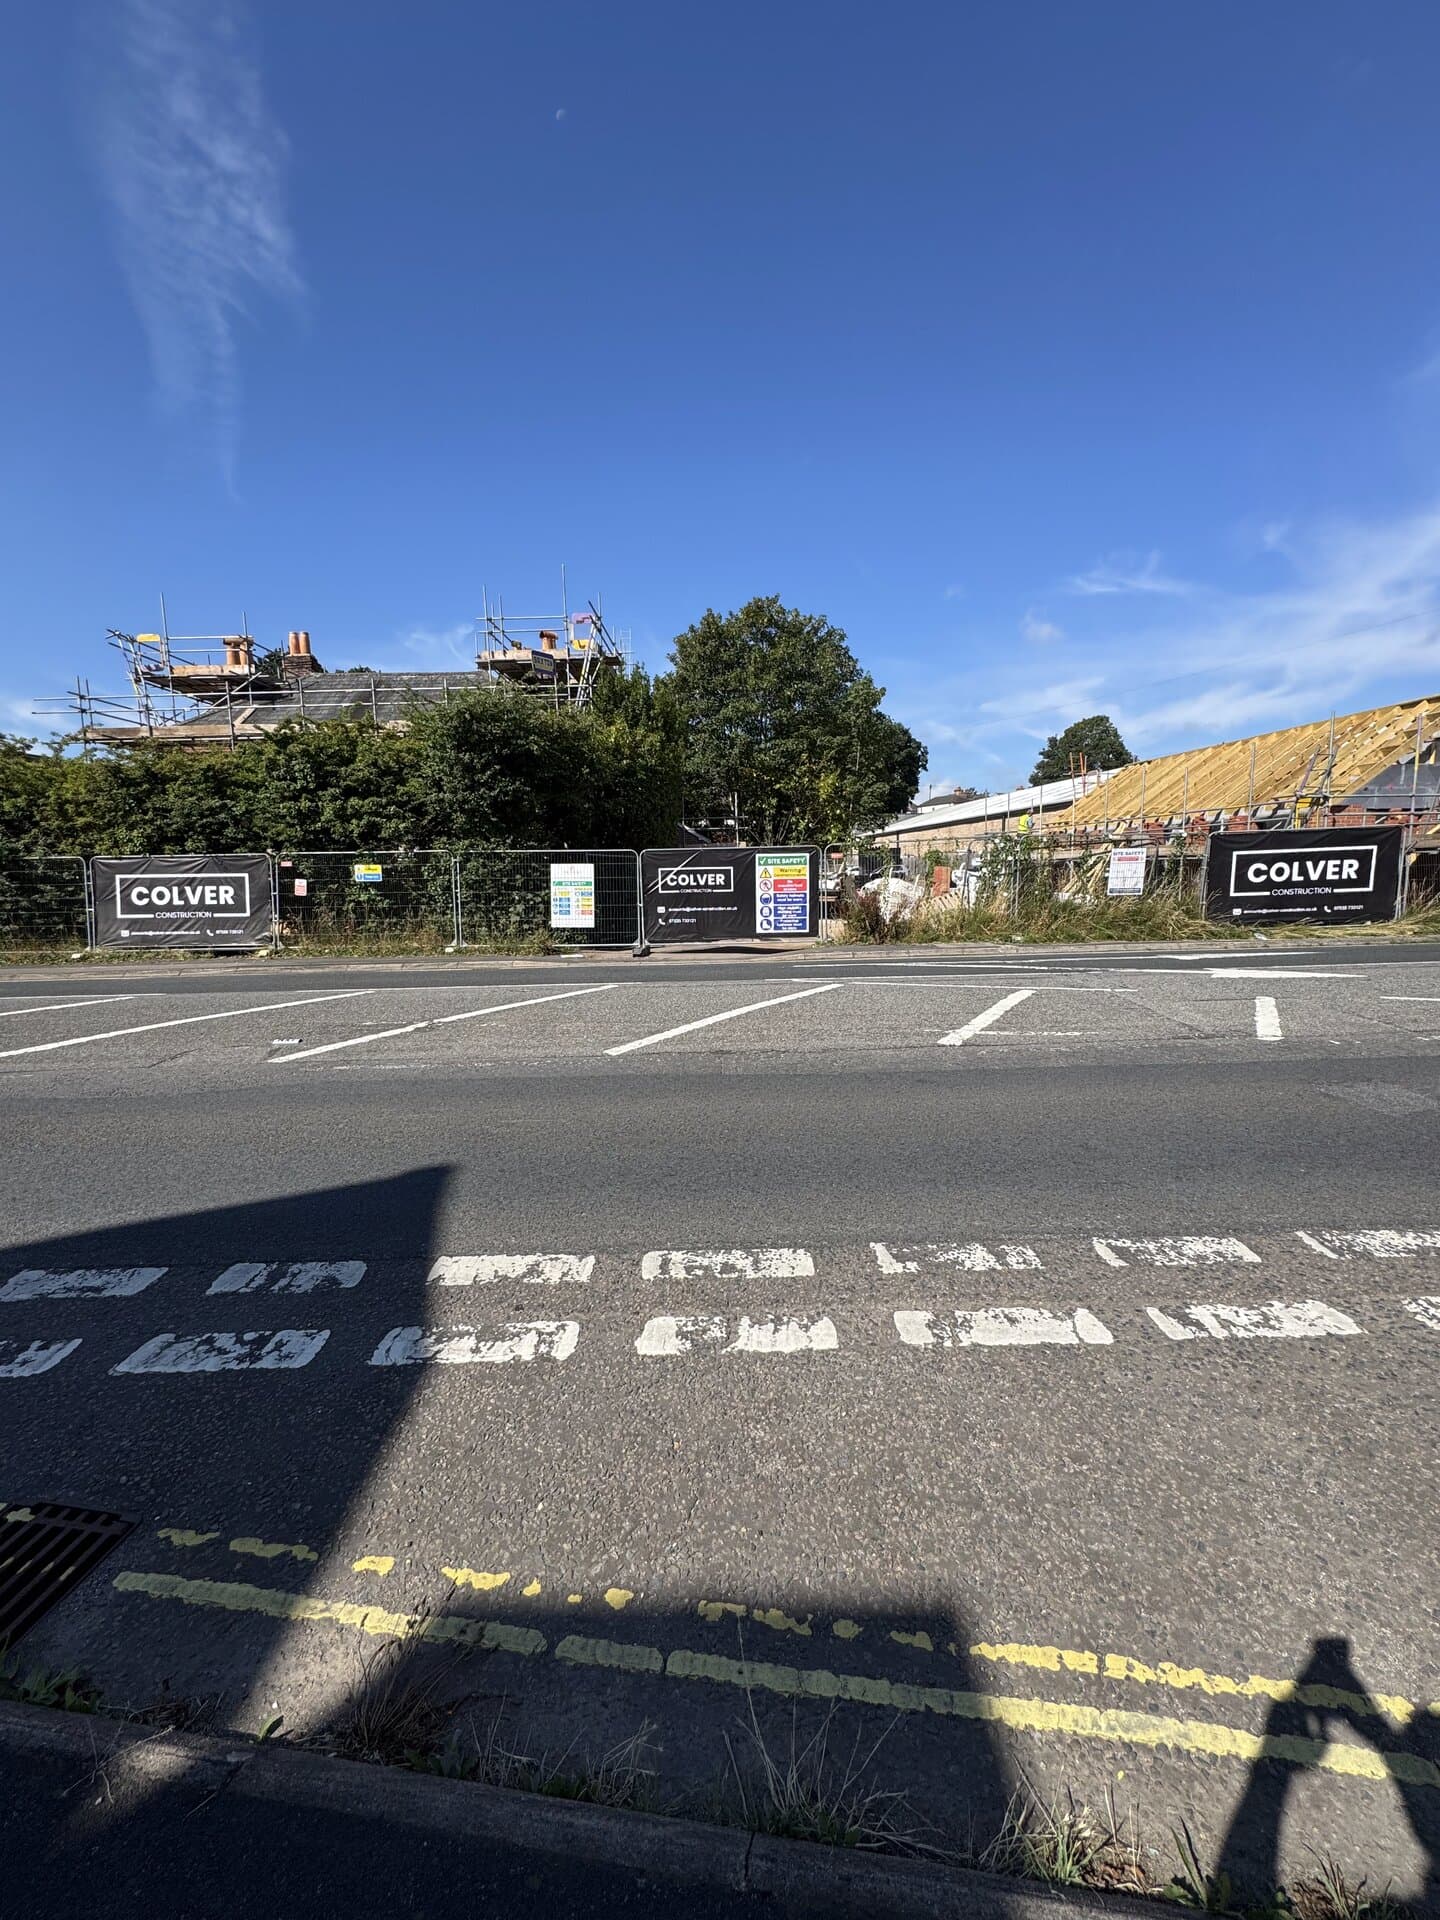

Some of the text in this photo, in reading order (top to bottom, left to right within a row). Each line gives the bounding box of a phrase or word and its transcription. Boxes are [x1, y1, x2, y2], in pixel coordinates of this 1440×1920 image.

[1247, 859, 1360, 883] COLVER
[667, 873, 726, 886] COLVER
[130, 885, 236, 906] COLVER
[1271, 887, 1332, 896] CONSTRUCTION
[155, 911, 212, 919] CONSTRUCTION
